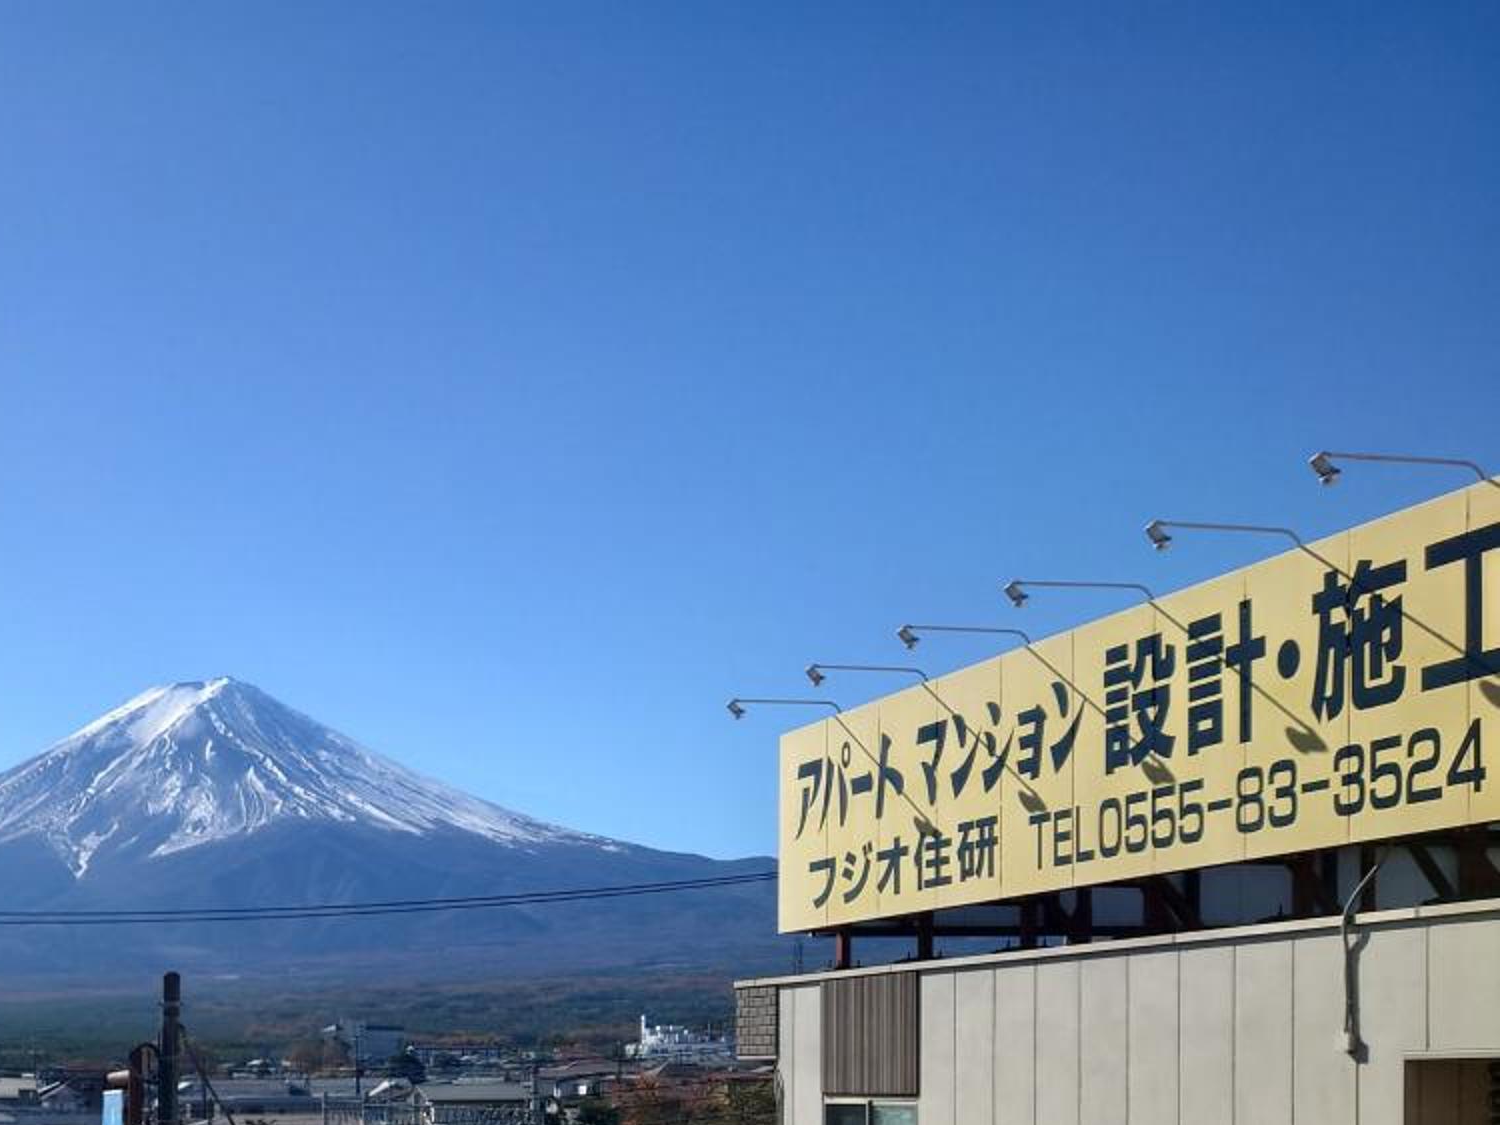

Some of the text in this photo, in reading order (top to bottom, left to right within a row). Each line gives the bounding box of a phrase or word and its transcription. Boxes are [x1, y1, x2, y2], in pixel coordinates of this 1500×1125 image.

[795, 521, 1500, 841] アパート マンション 設計・施工
[808, 813, 1000, 909] フジオ住研
